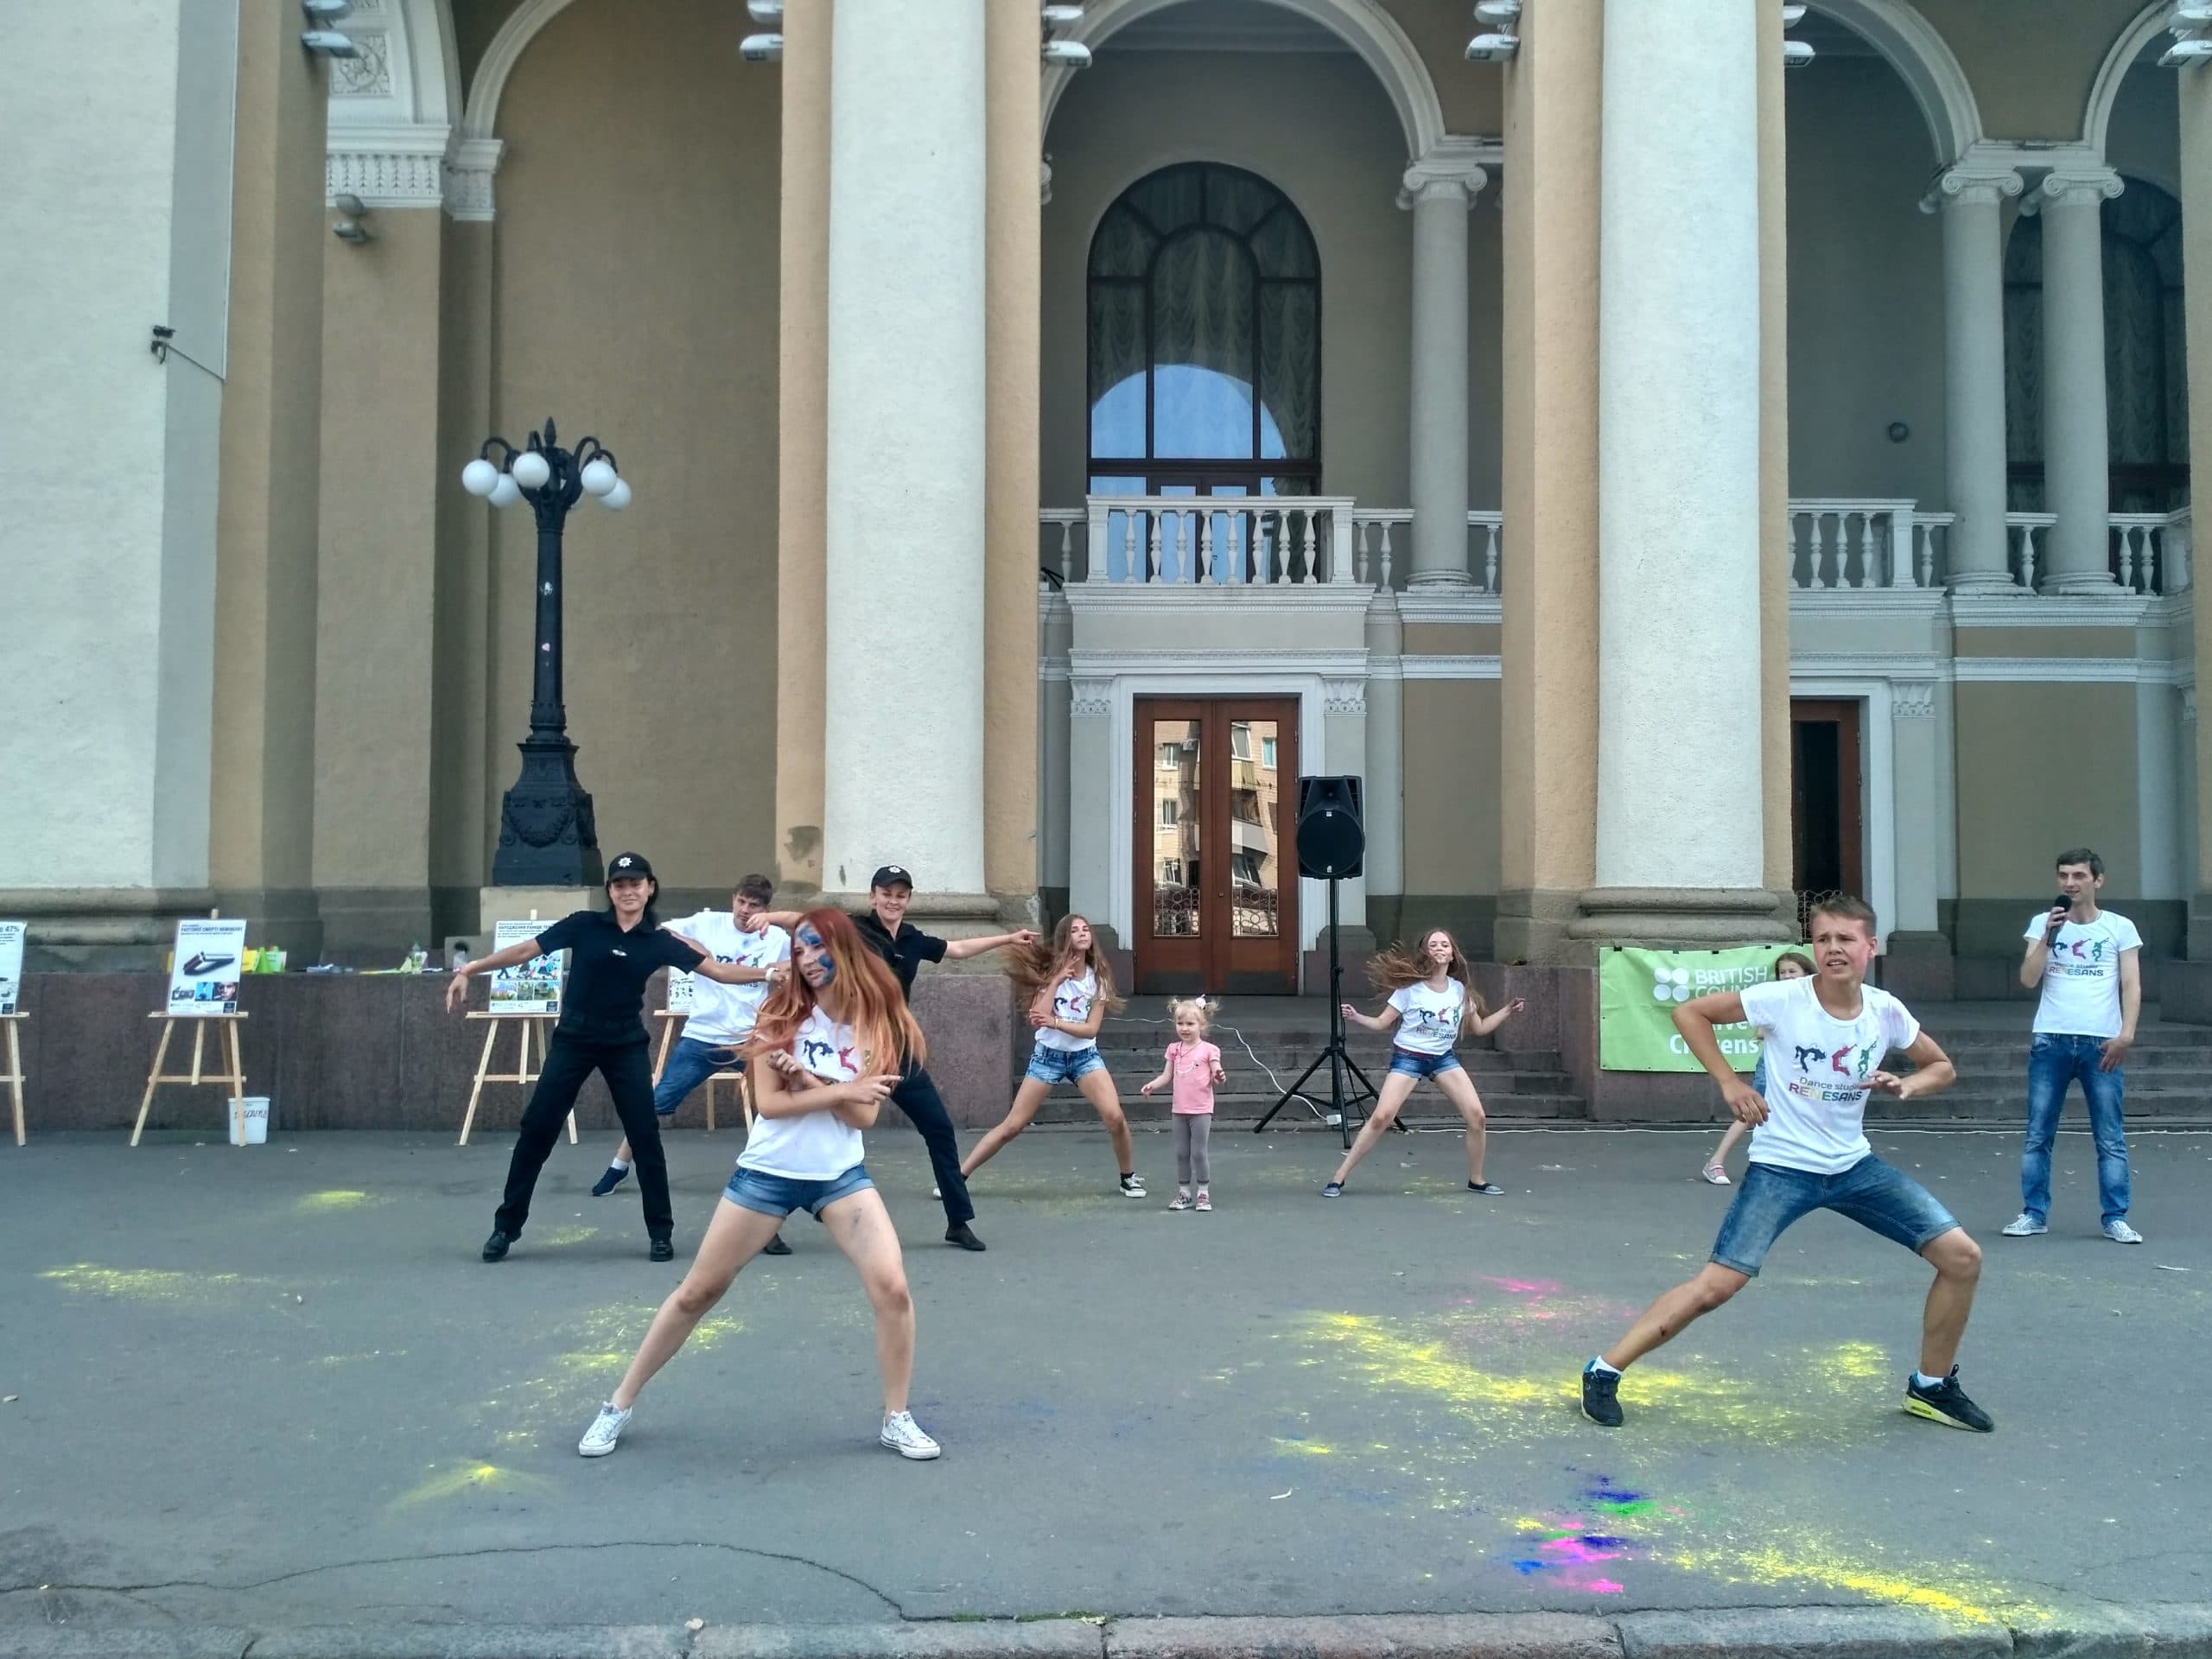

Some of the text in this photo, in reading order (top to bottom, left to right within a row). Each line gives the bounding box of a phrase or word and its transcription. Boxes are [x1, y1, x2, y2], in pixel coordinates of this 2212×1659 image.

[1694, 967, 1768, 985] BRITISH
[1789, 1083, 1863, 1102] RENESANS
[1799, 1077, 1833, 1090] Dance
